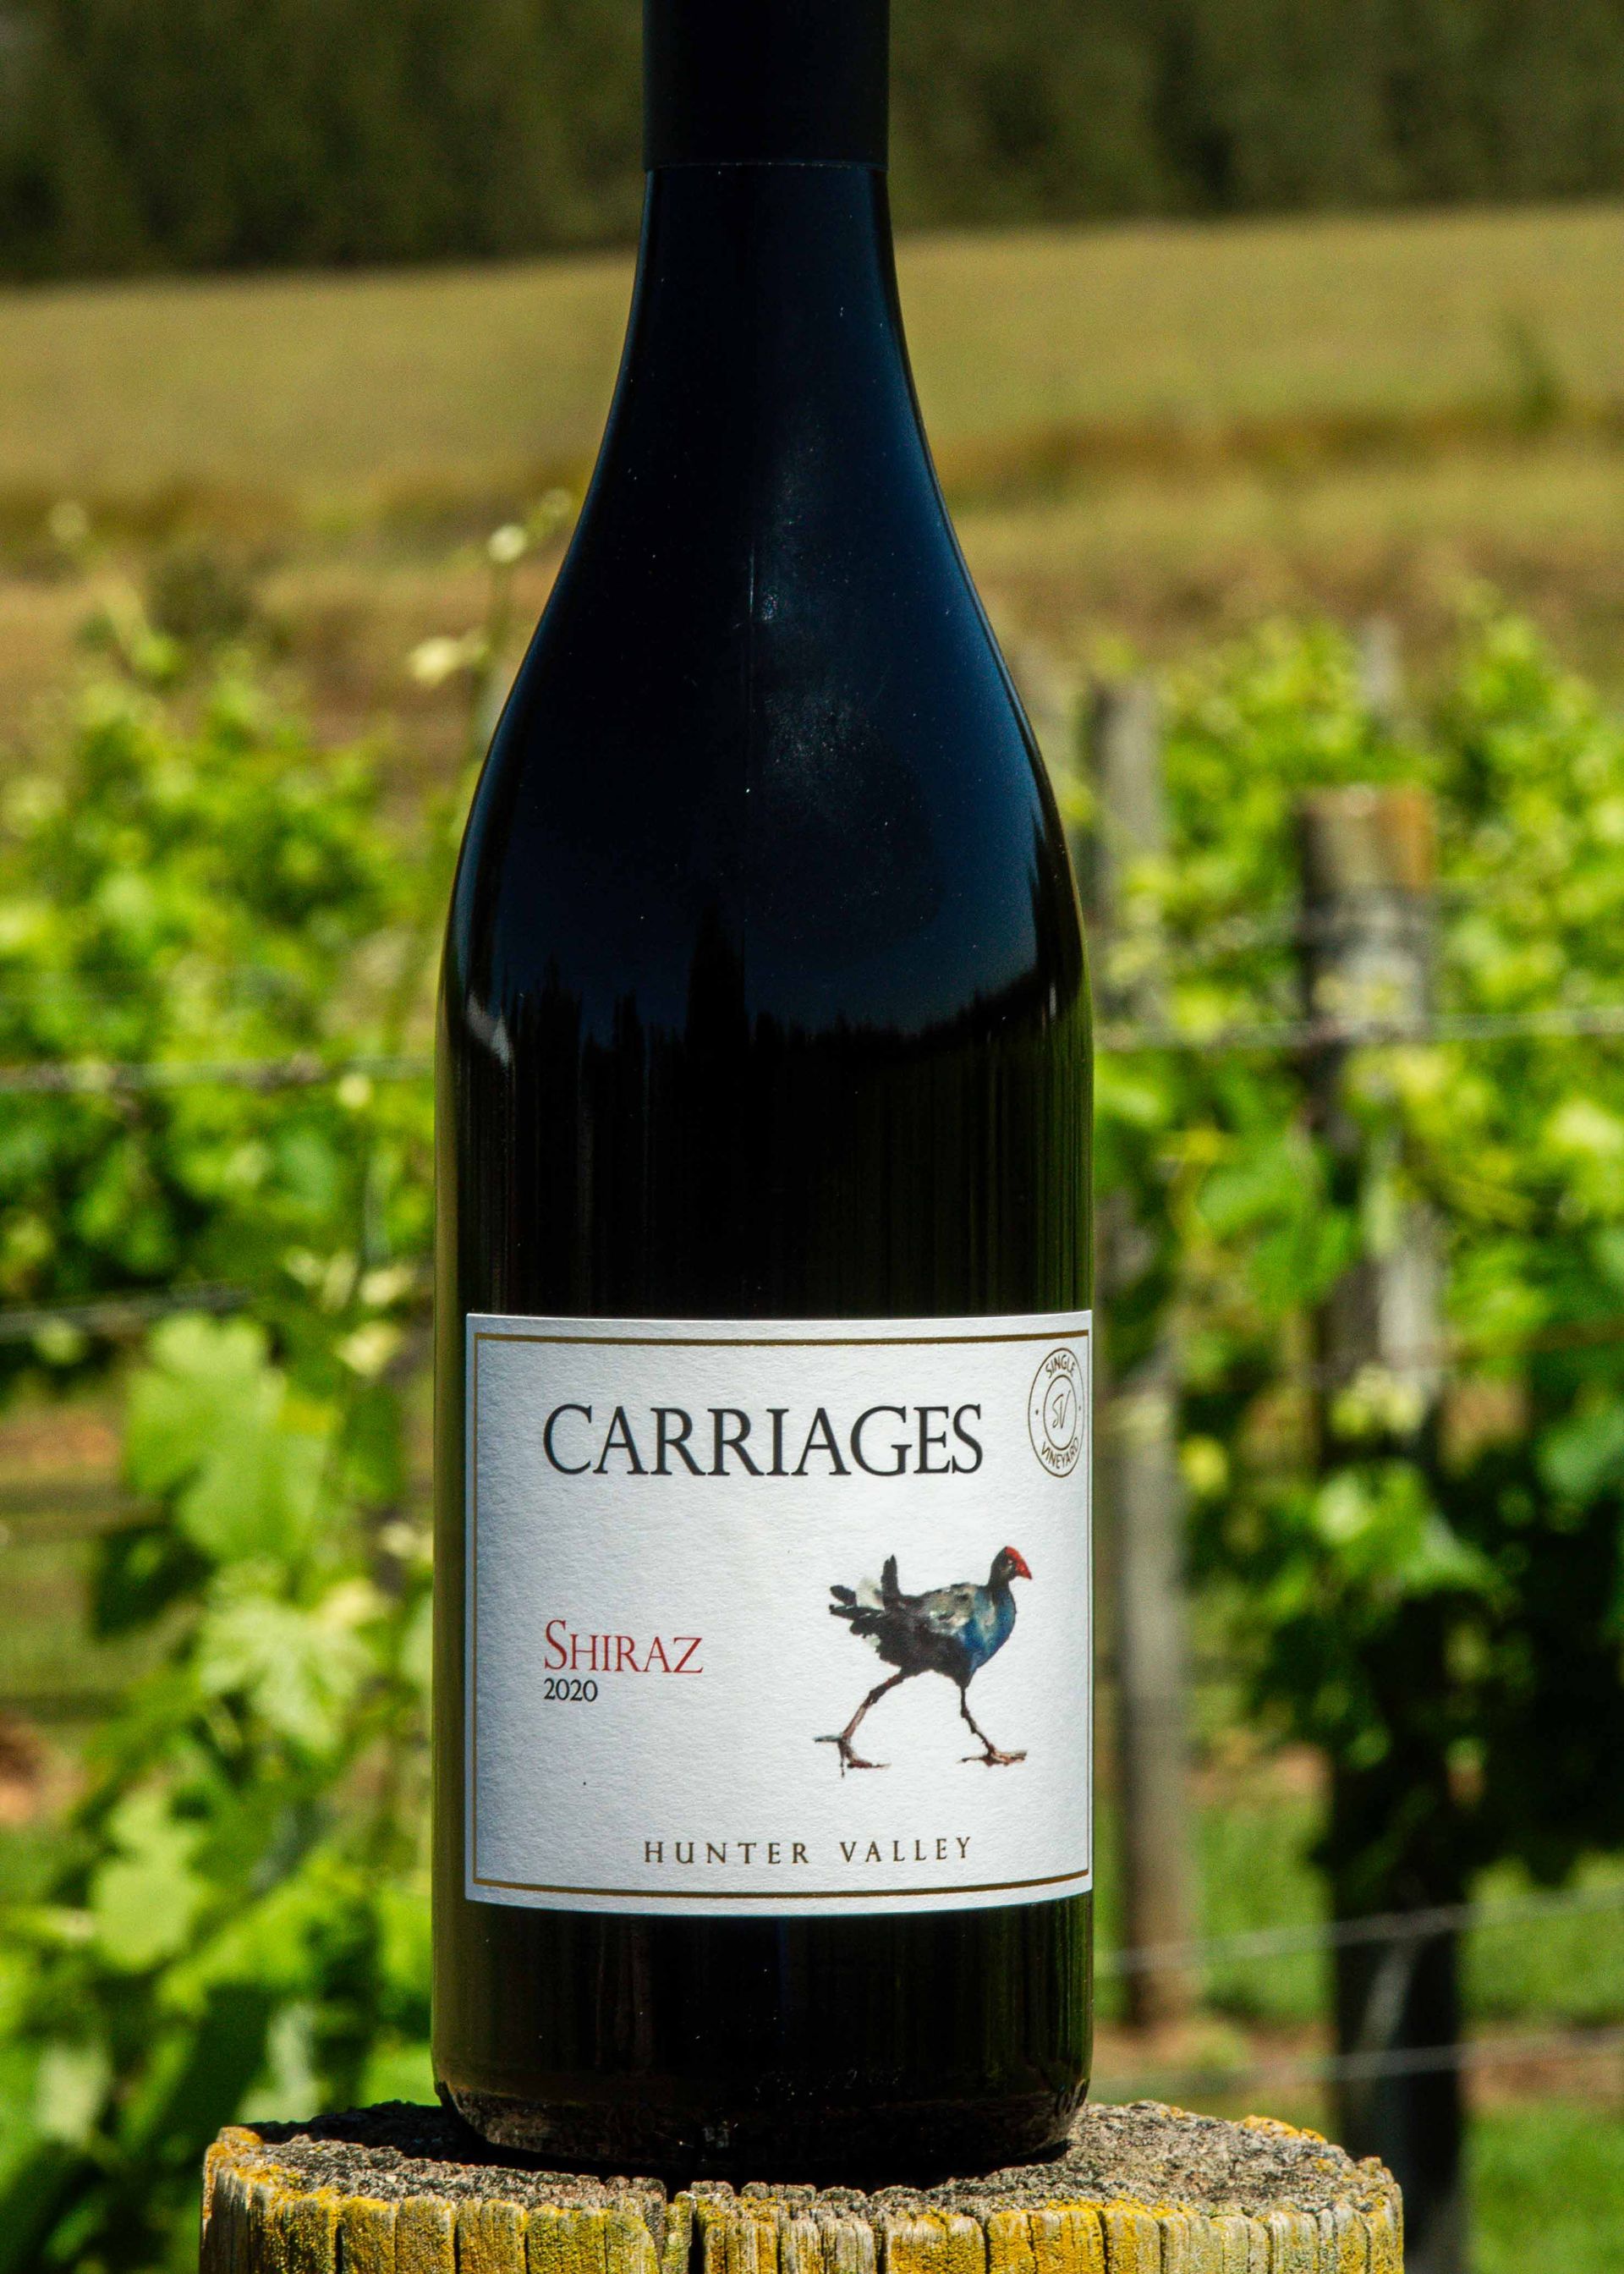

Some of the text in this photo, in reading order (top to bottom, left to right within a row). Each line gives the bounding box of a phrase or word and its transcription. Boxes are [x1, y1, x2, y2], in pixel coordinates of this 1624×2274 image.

[1045, 1355, 1076, 1378] SINGLE
[544, 1403, 984, 1476] CARRIAGES
[1041, 1437, 1079, 1469] VINEYARD
[544, 1619, 704, 1673] SHIRAZ
[543, 1678, 599, 1702] 2020
[644, 1836, 972, 1865] HUNTER VALLEY
